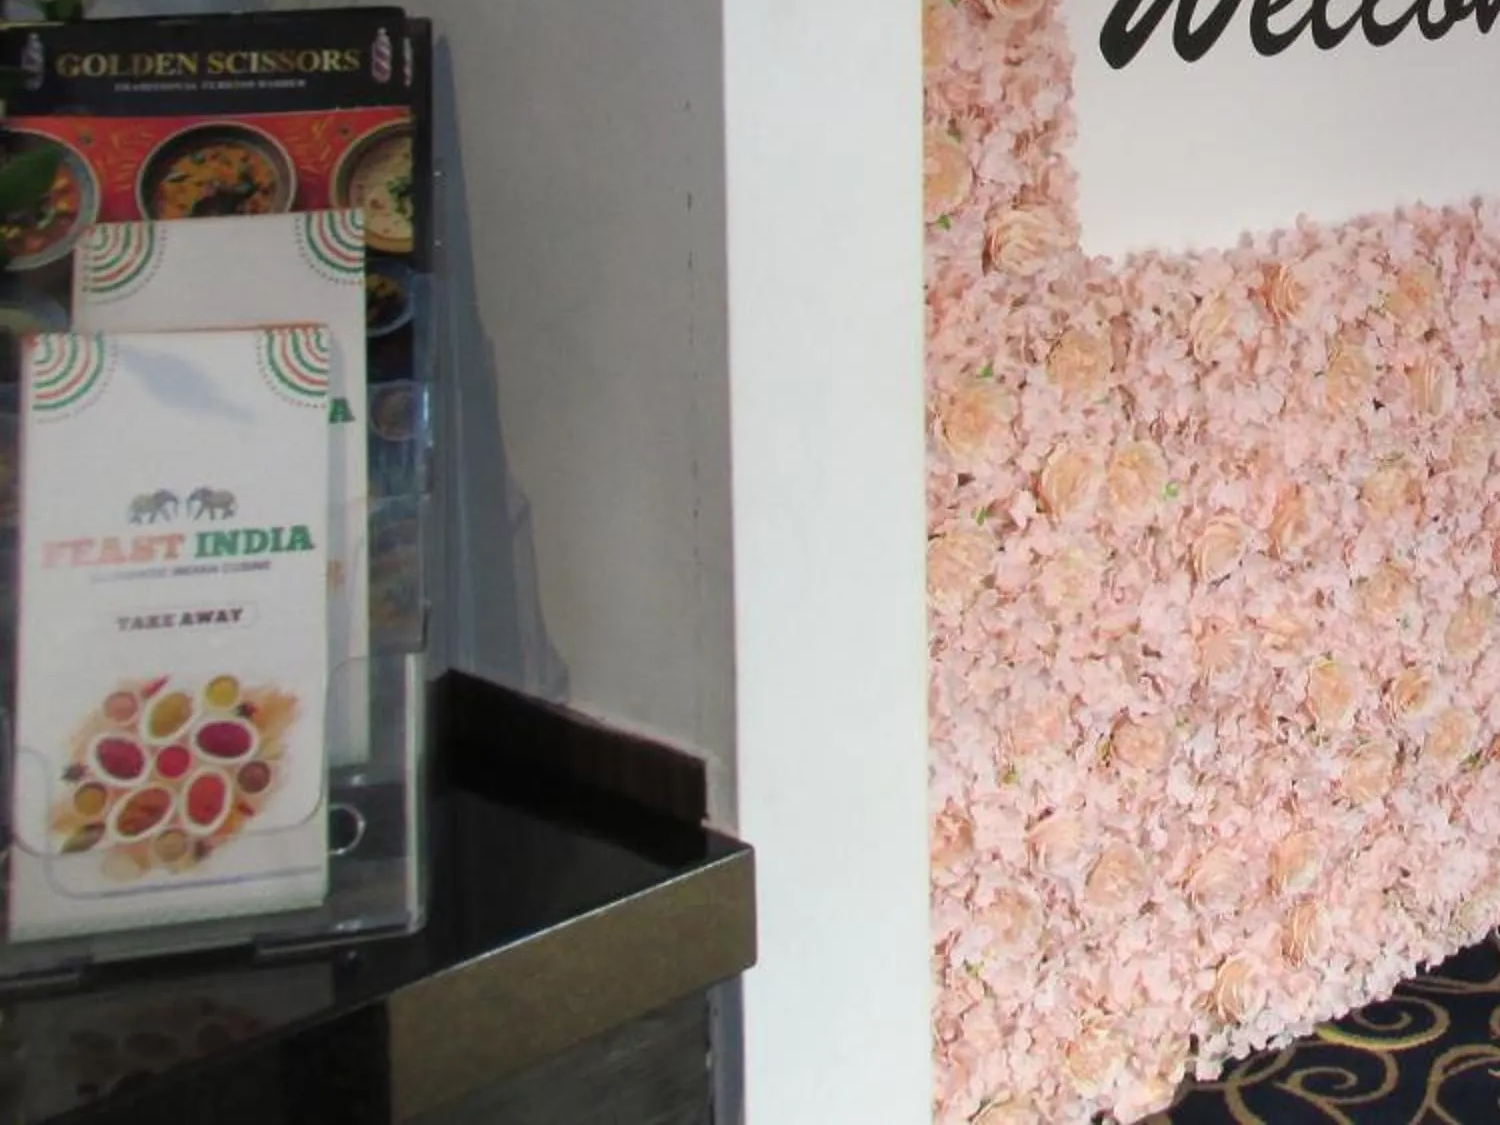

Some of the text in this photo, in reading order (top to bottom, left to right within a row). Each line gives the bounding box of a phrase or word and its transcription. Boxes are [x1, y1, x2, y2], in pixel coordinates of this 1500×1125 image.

[56, 49, 361, 78] GOLDEN SCISSORS
[41, 525, 316, 568] FEAST INDIA
[117, 608, 244, 632] TAKE AWAY
